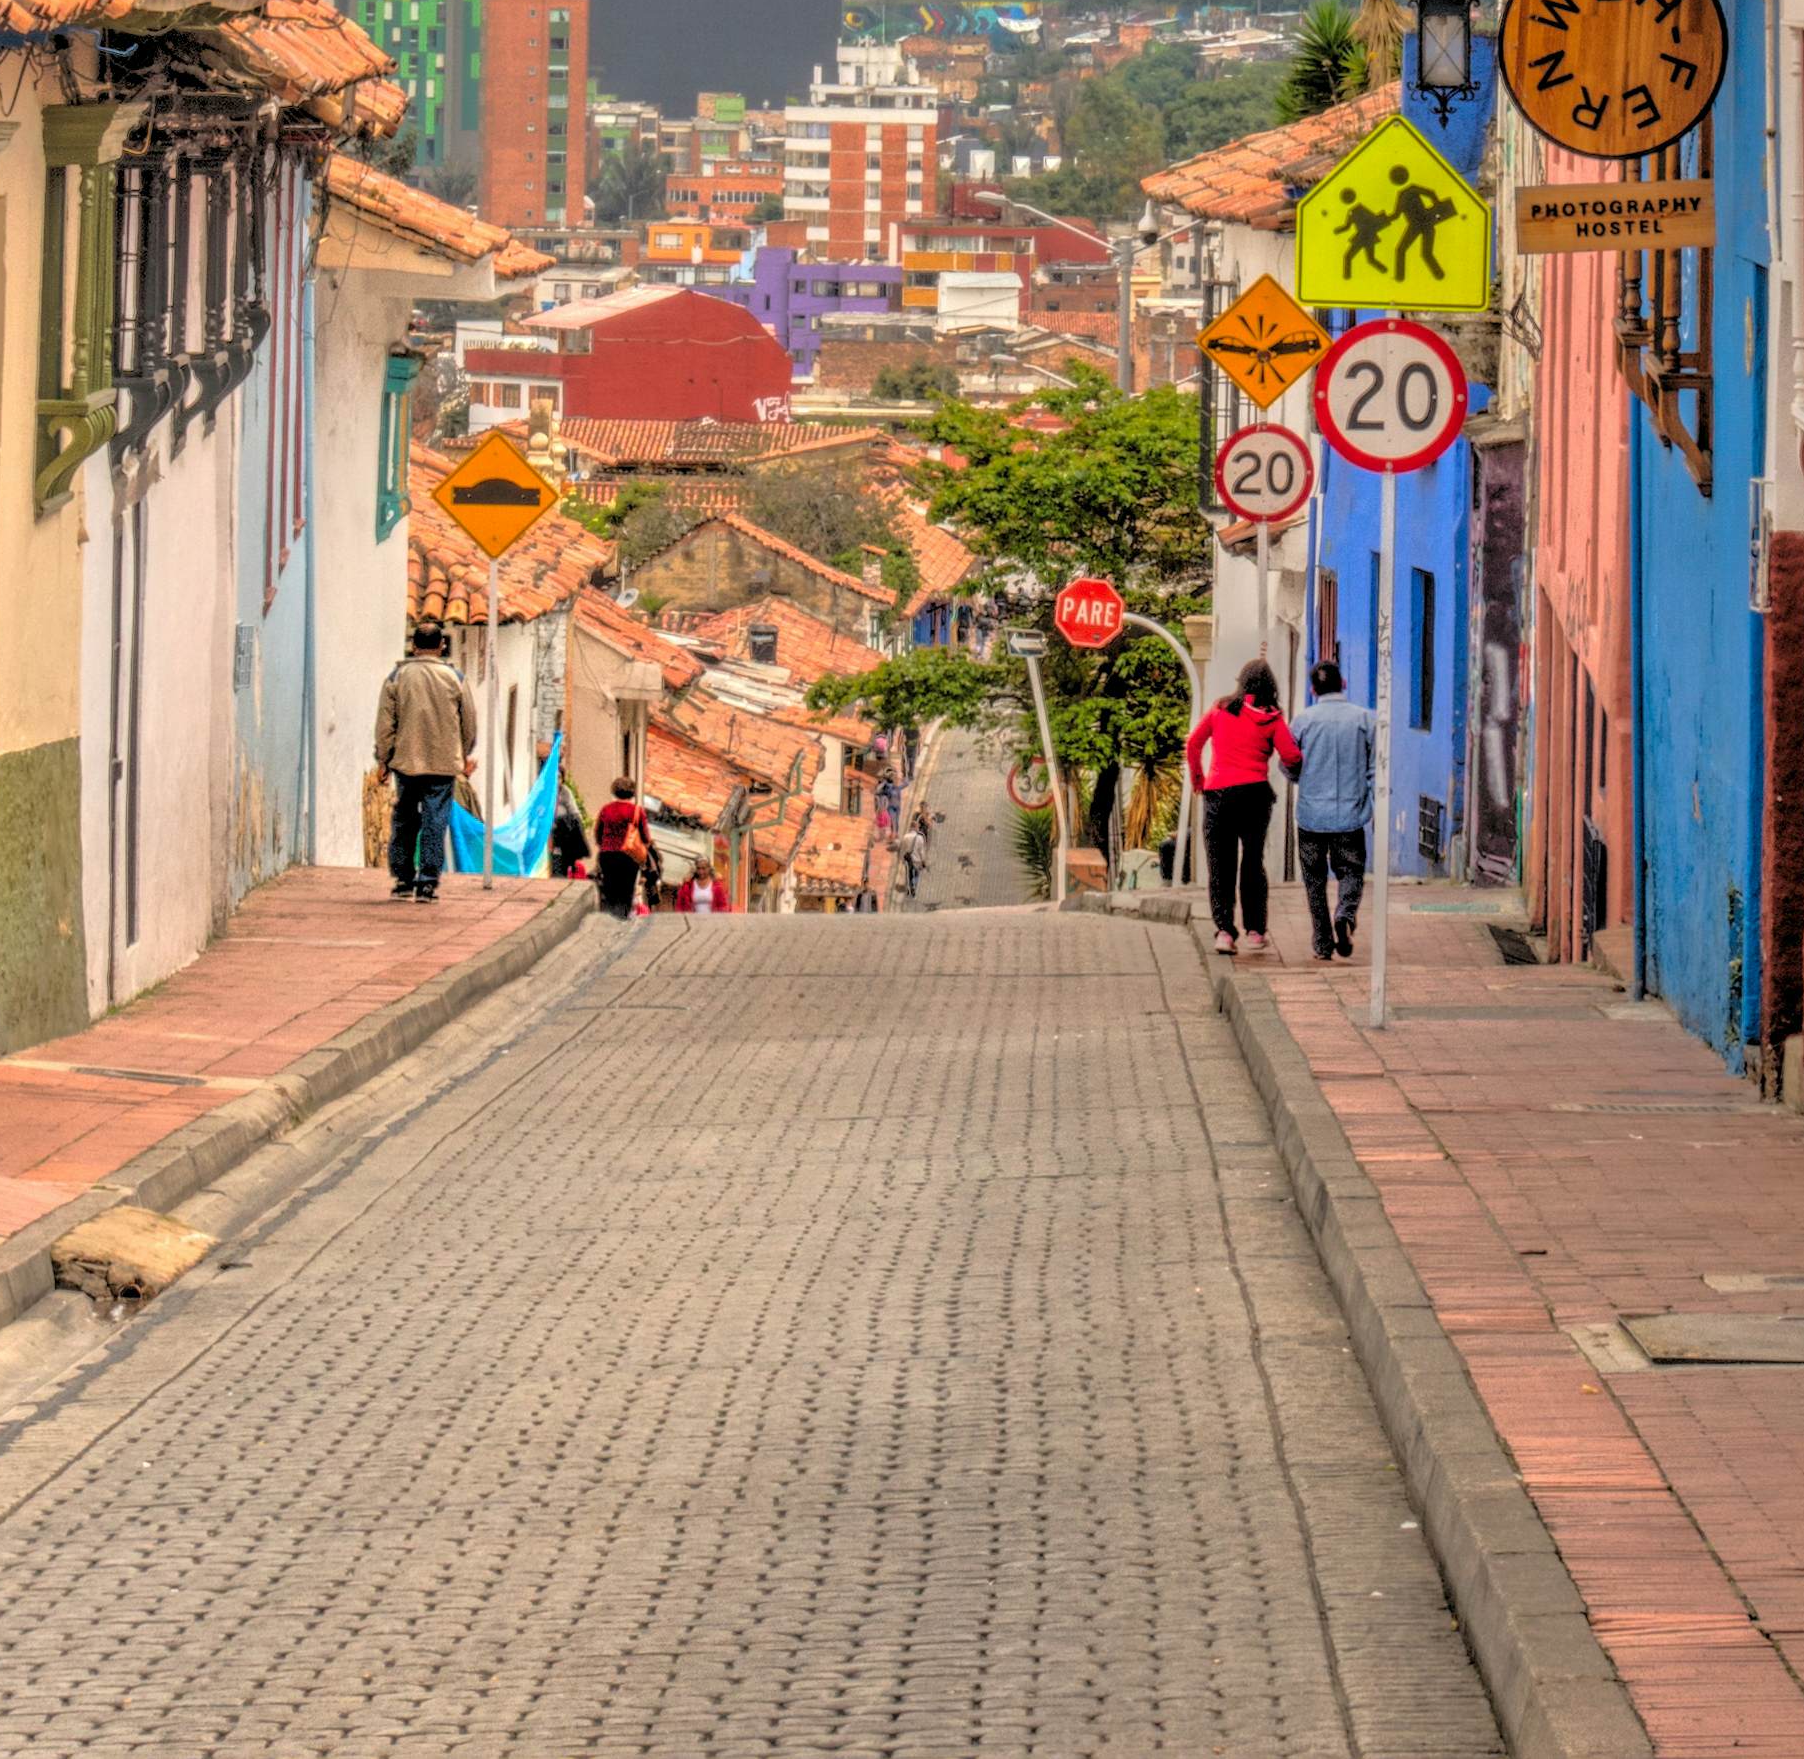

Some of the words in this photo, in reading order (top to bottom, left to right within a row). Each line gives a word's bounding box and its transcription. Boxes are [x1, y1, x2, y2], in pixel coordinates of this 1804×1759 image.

[1531, 197, 1702, 219] PHOTOGRAPHY
[1576, 220, 1664, 238] HOSTEL
[1344, 359, 1439, 432] 20
[1232, 449, 1295, 496] 20
[1061, 596, 1118, 628] PARE
